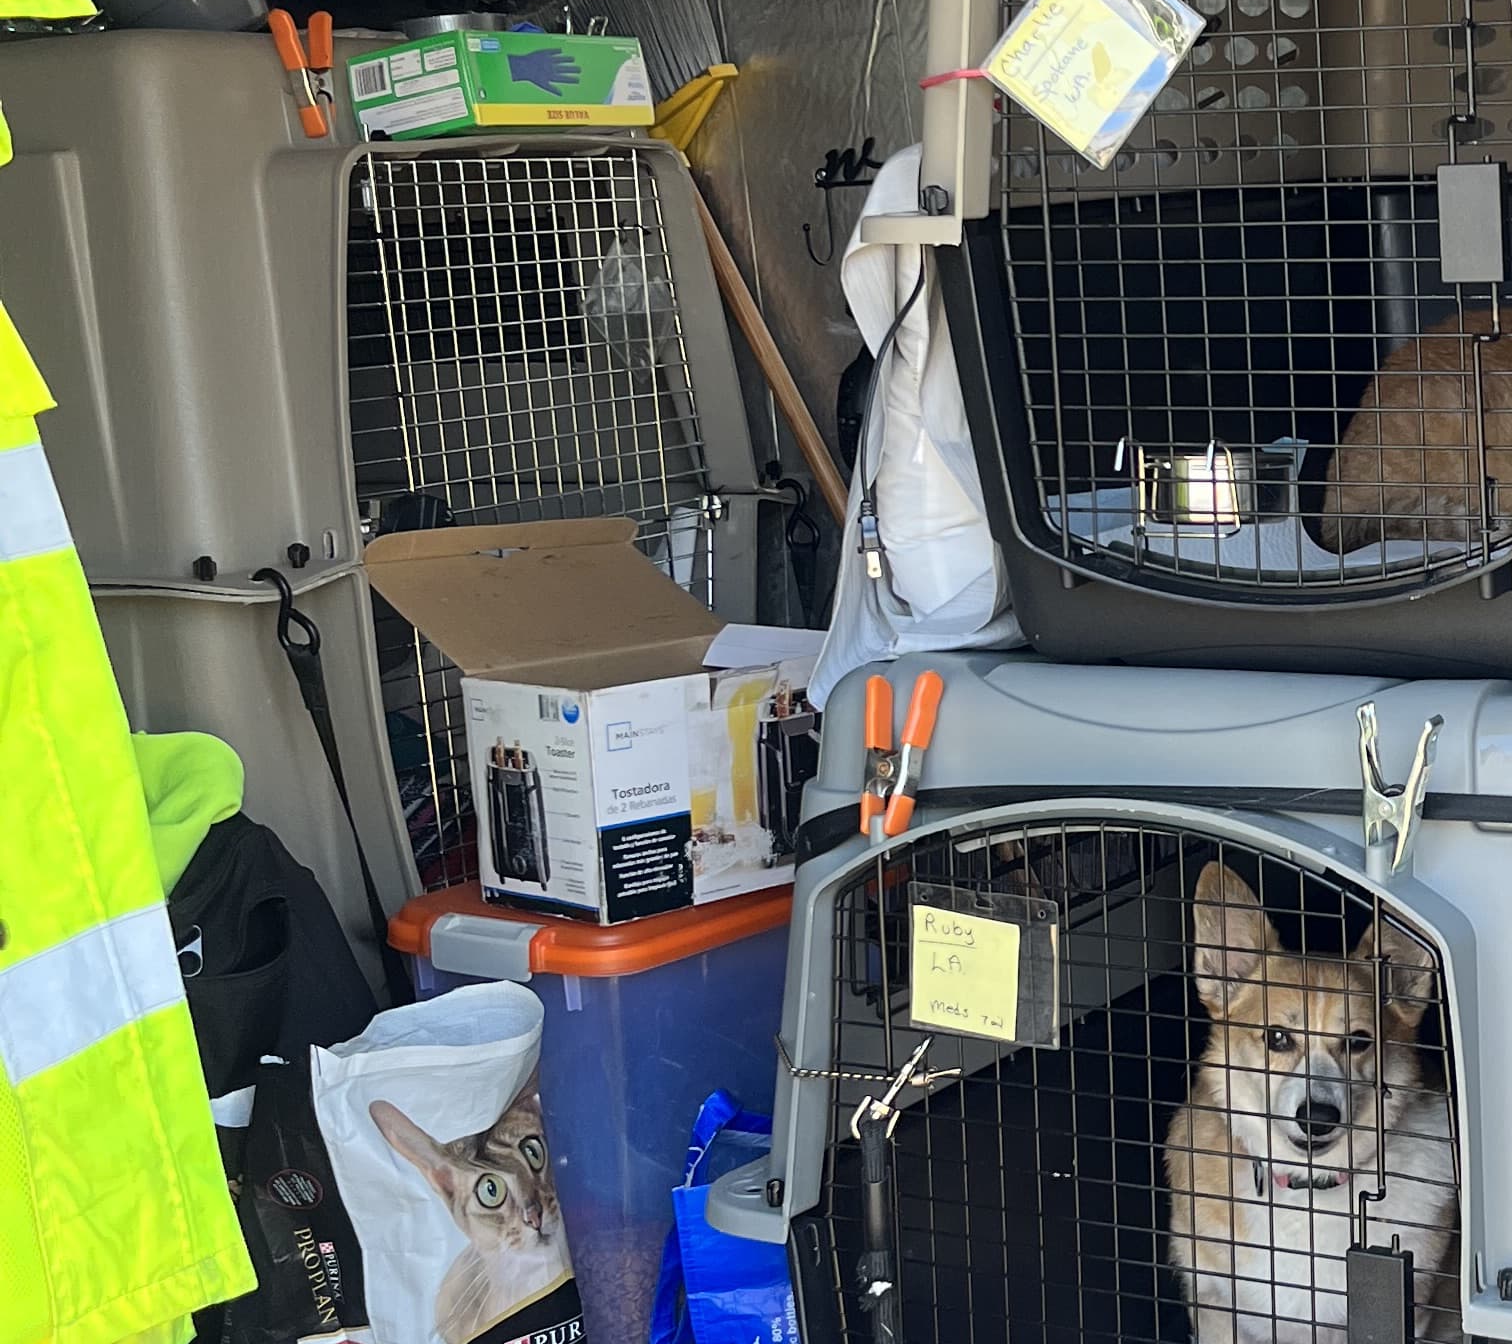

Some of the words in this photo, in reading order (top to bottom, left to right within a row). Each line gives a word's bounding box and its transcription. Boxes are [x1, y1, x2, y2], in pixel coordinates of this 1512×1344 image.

[1001, 1, 1064, 79] Charlie
[611, 781, 671, 800] Tostadora
[924, 913, 976, 945] Ruby
[771, 1316, 783, 1342] 80%
